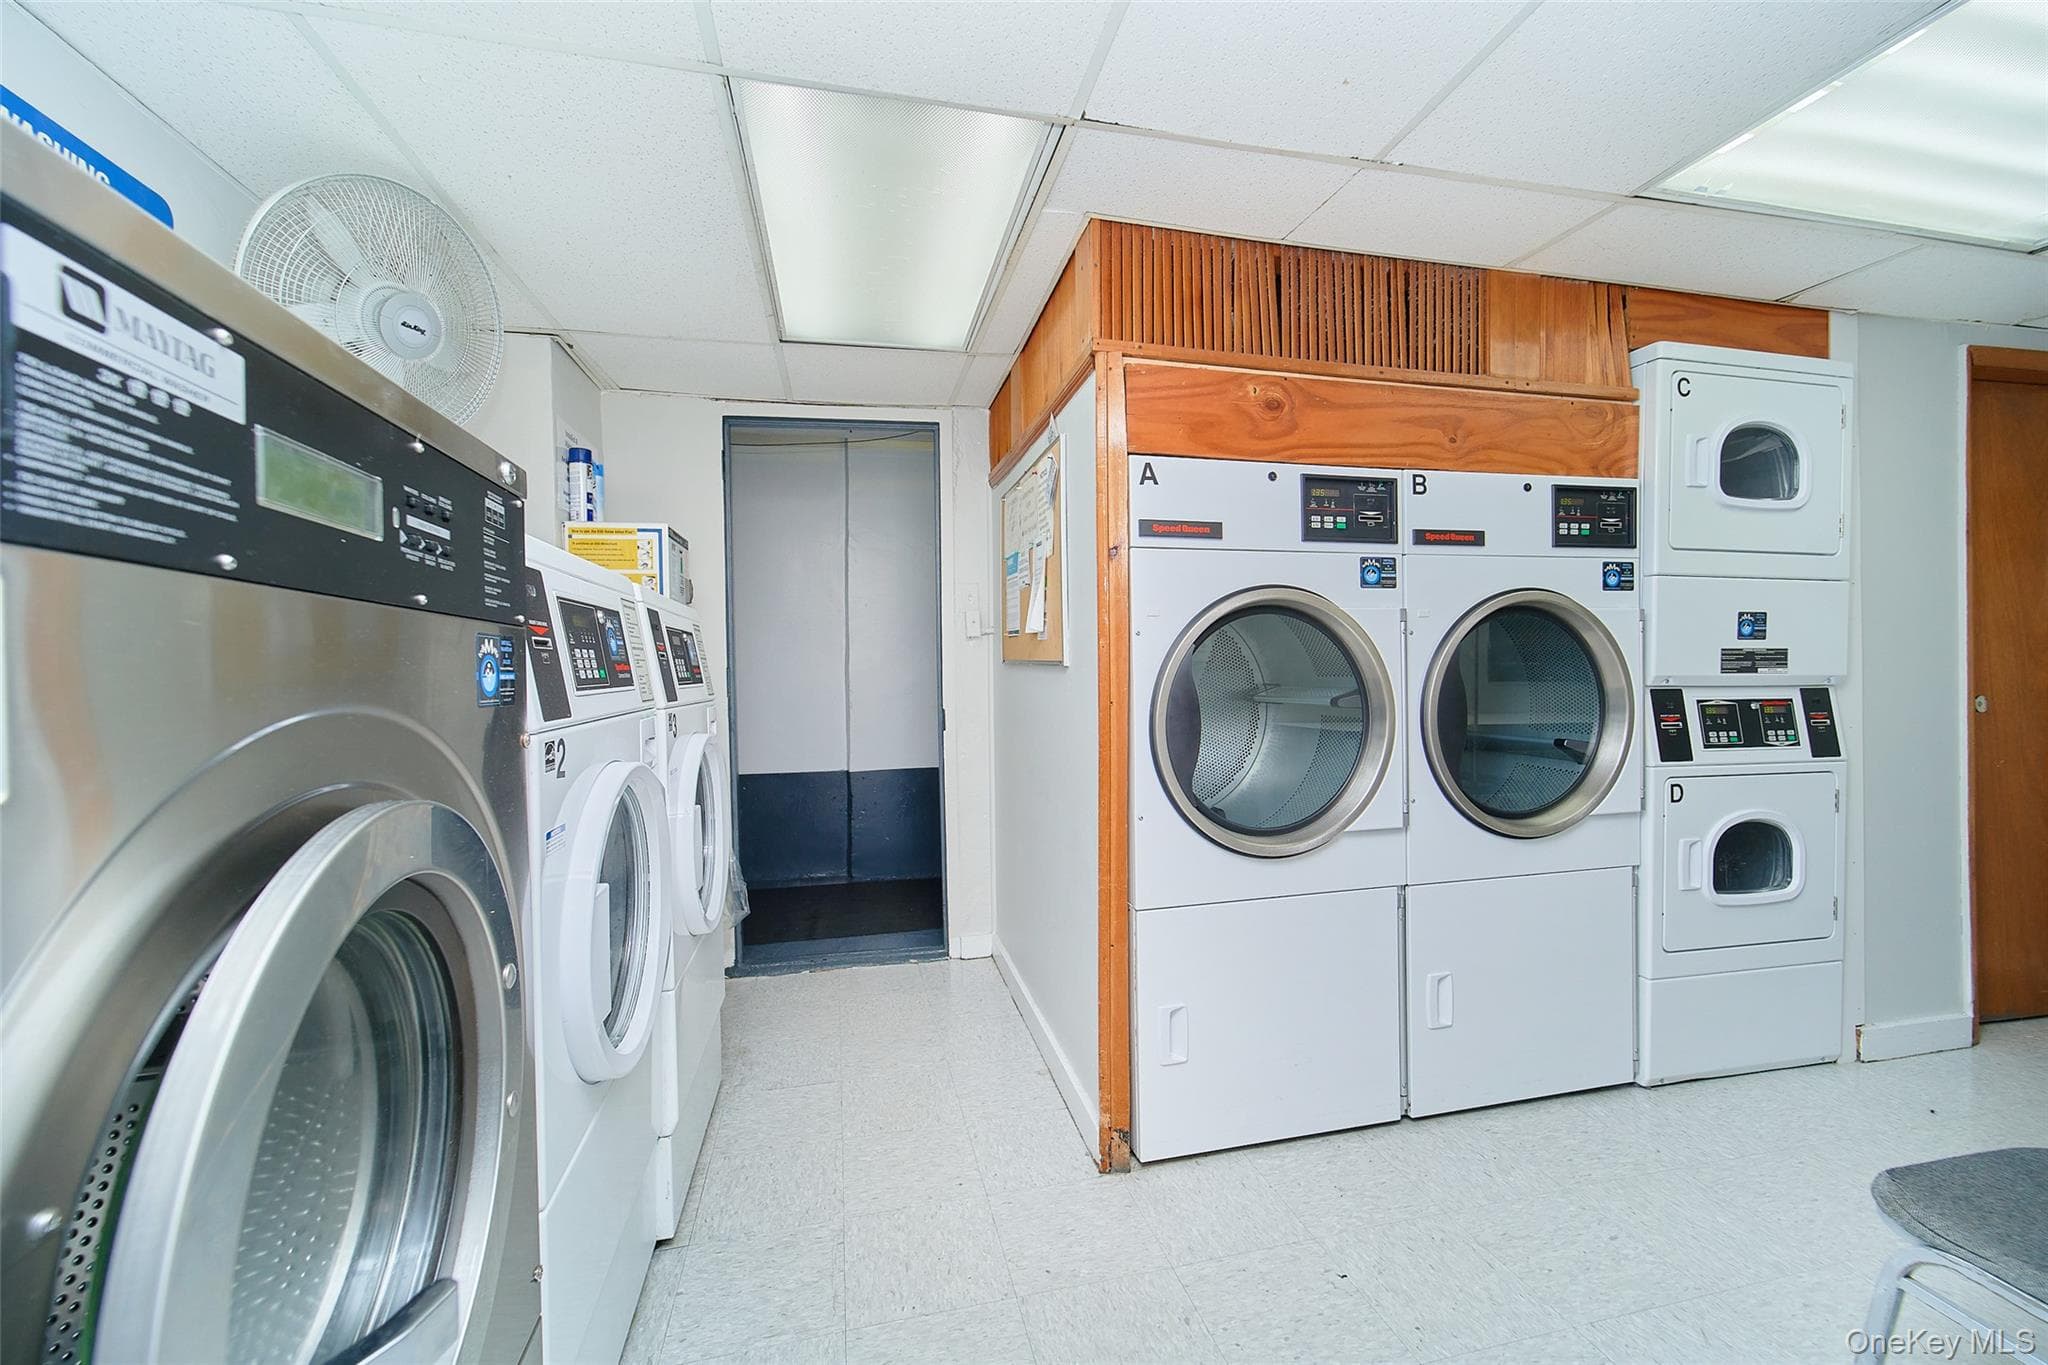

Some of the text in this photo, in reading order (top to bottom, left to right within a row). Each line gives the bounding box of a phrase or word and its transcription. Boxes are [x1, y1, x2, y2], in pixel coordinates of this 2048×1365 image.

[113, 305, 217, 378] MAYTAG
[1677, 377, 1691, 397] C
[1139, 462, 1159, 485] A
[1412, 474, 1428, 495] B
[1151, 523, 1211, 533] Speed Queen
[672, 713, 678, 738] 3
[556, 738, 566, 779] 2
[1670, 783, 1684, 803] D
